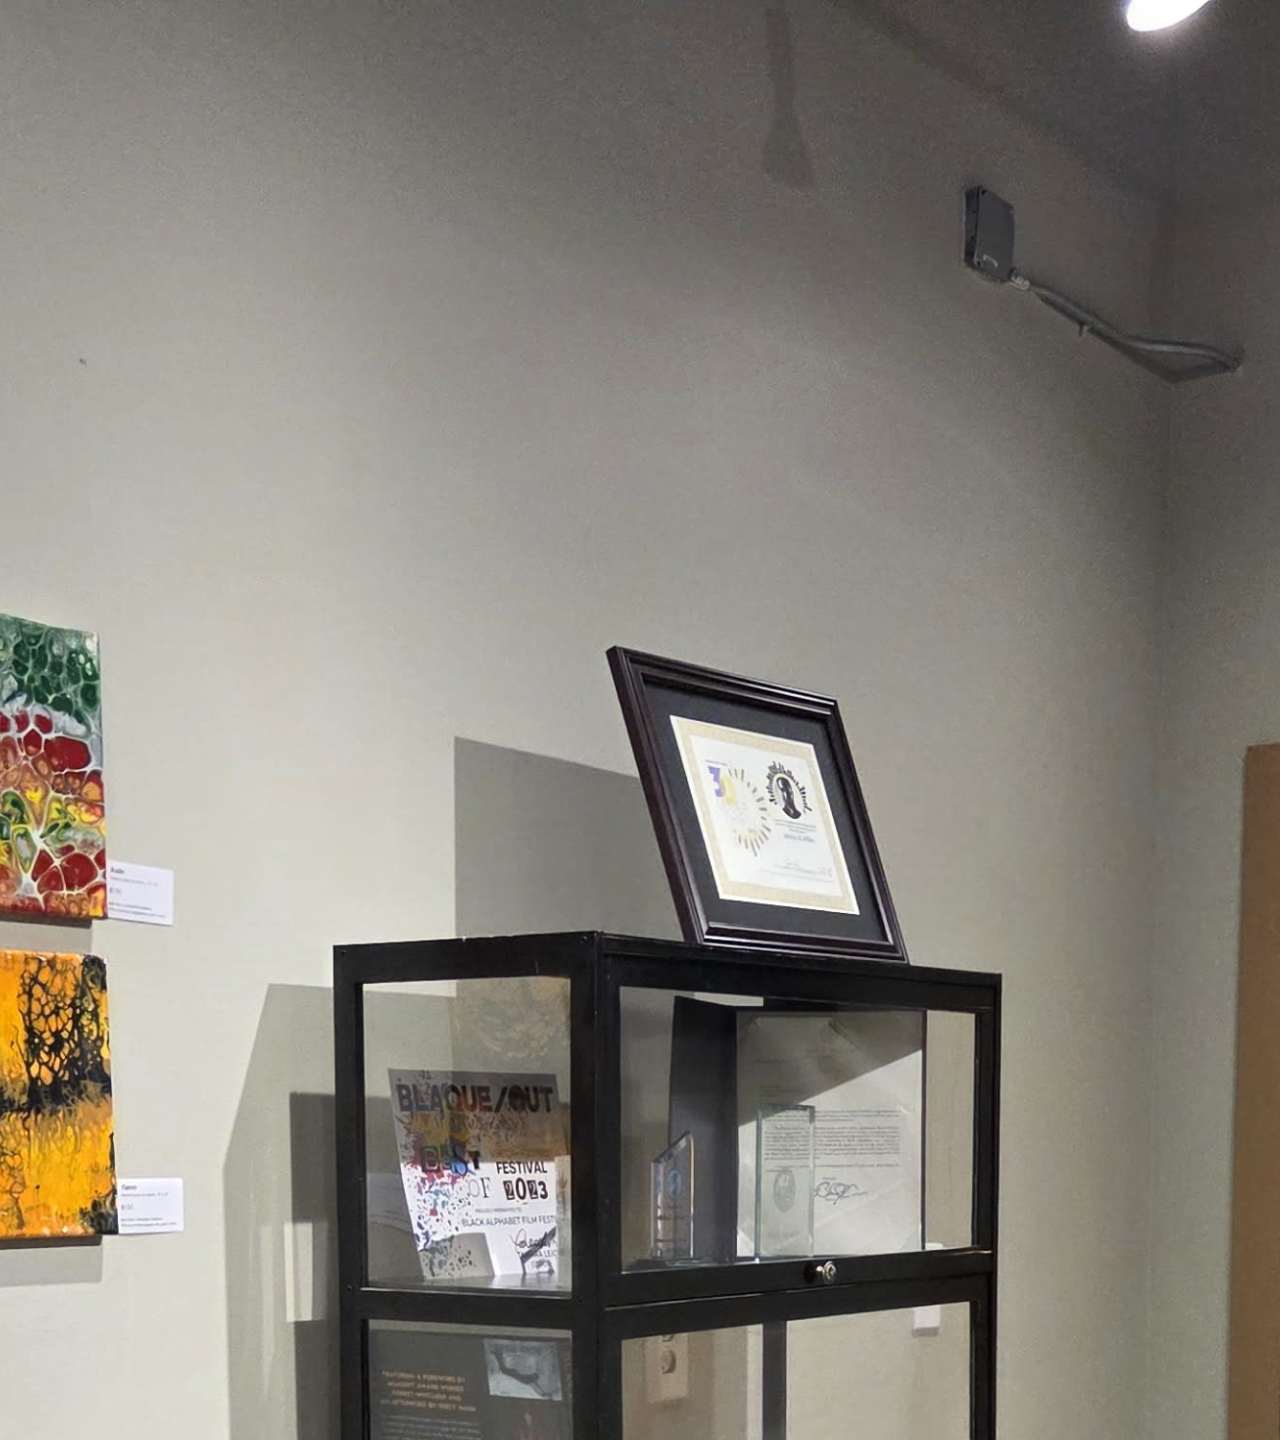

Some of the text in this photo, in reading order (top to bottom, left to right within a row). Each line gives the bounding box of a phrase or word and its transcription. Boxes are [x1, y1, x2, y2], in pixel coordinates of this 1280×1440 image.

[395, 1083, 554, 1113] BLAQUE/OUT
[496, 1160, 548, 1175] FESTIVAL
[469, 1177, 492, 1199] OF
[503, 1177, 549, 1201] 2023
[461, 1217, 484, 1227] BLACK
[486, 1216, 521, 1226] ALPHABET
[521, 1215, 538, 1225] FILM
